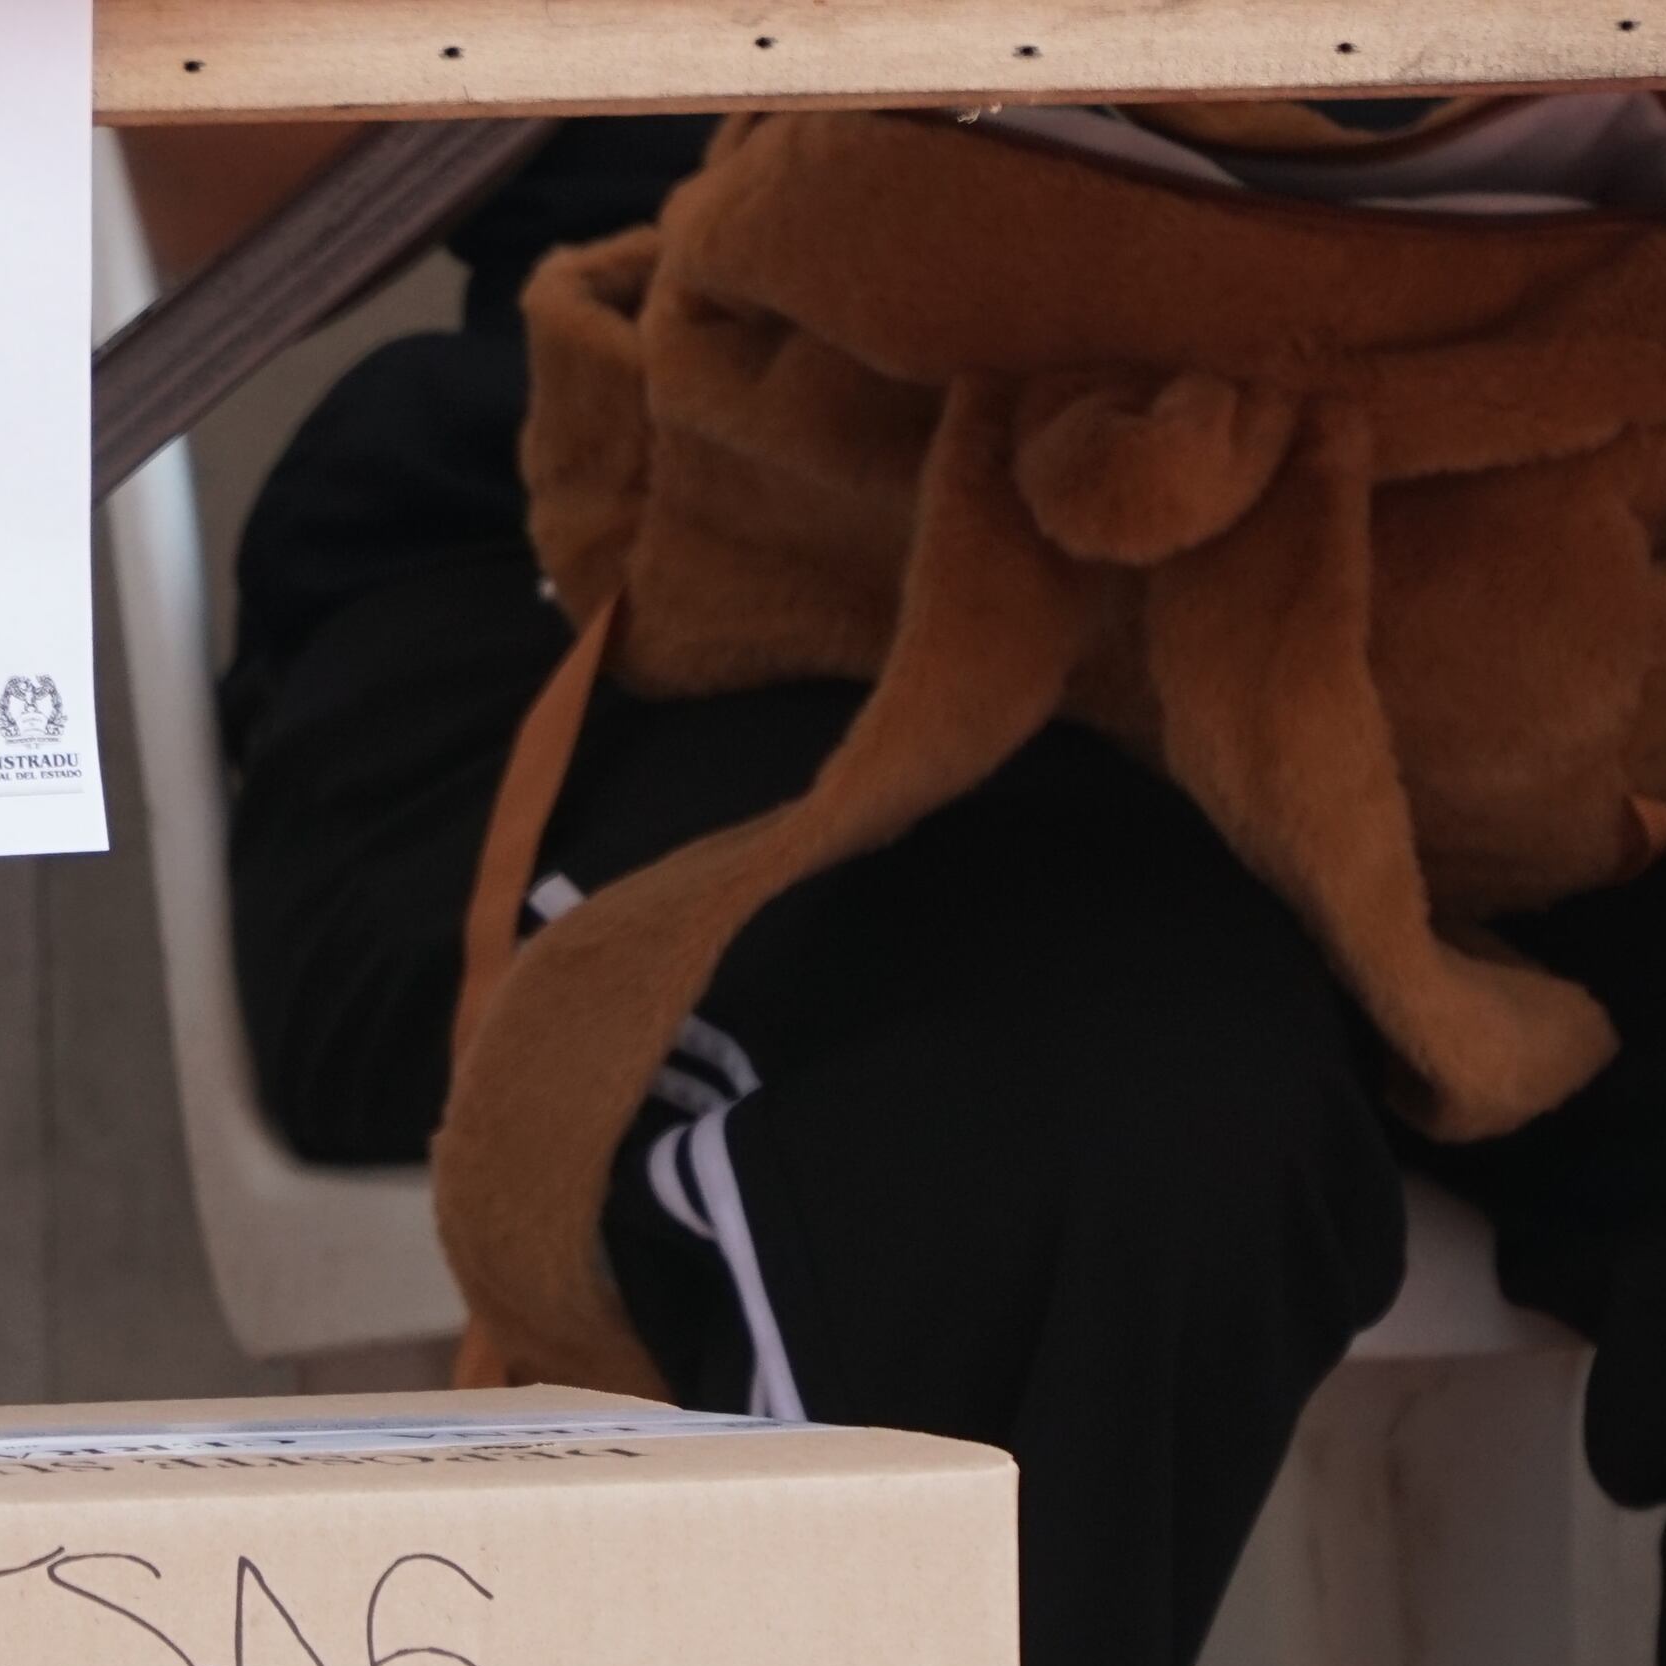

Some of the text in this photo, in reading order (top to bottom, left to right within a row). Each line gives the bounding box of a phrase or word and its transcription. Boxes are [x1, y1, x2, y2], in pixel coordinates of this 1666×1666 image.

[16, 771, 36, 780] DEL
[40, 769, 82, 778] ESTADO
[135, 1447, 646, 1470] DEPOSITE
